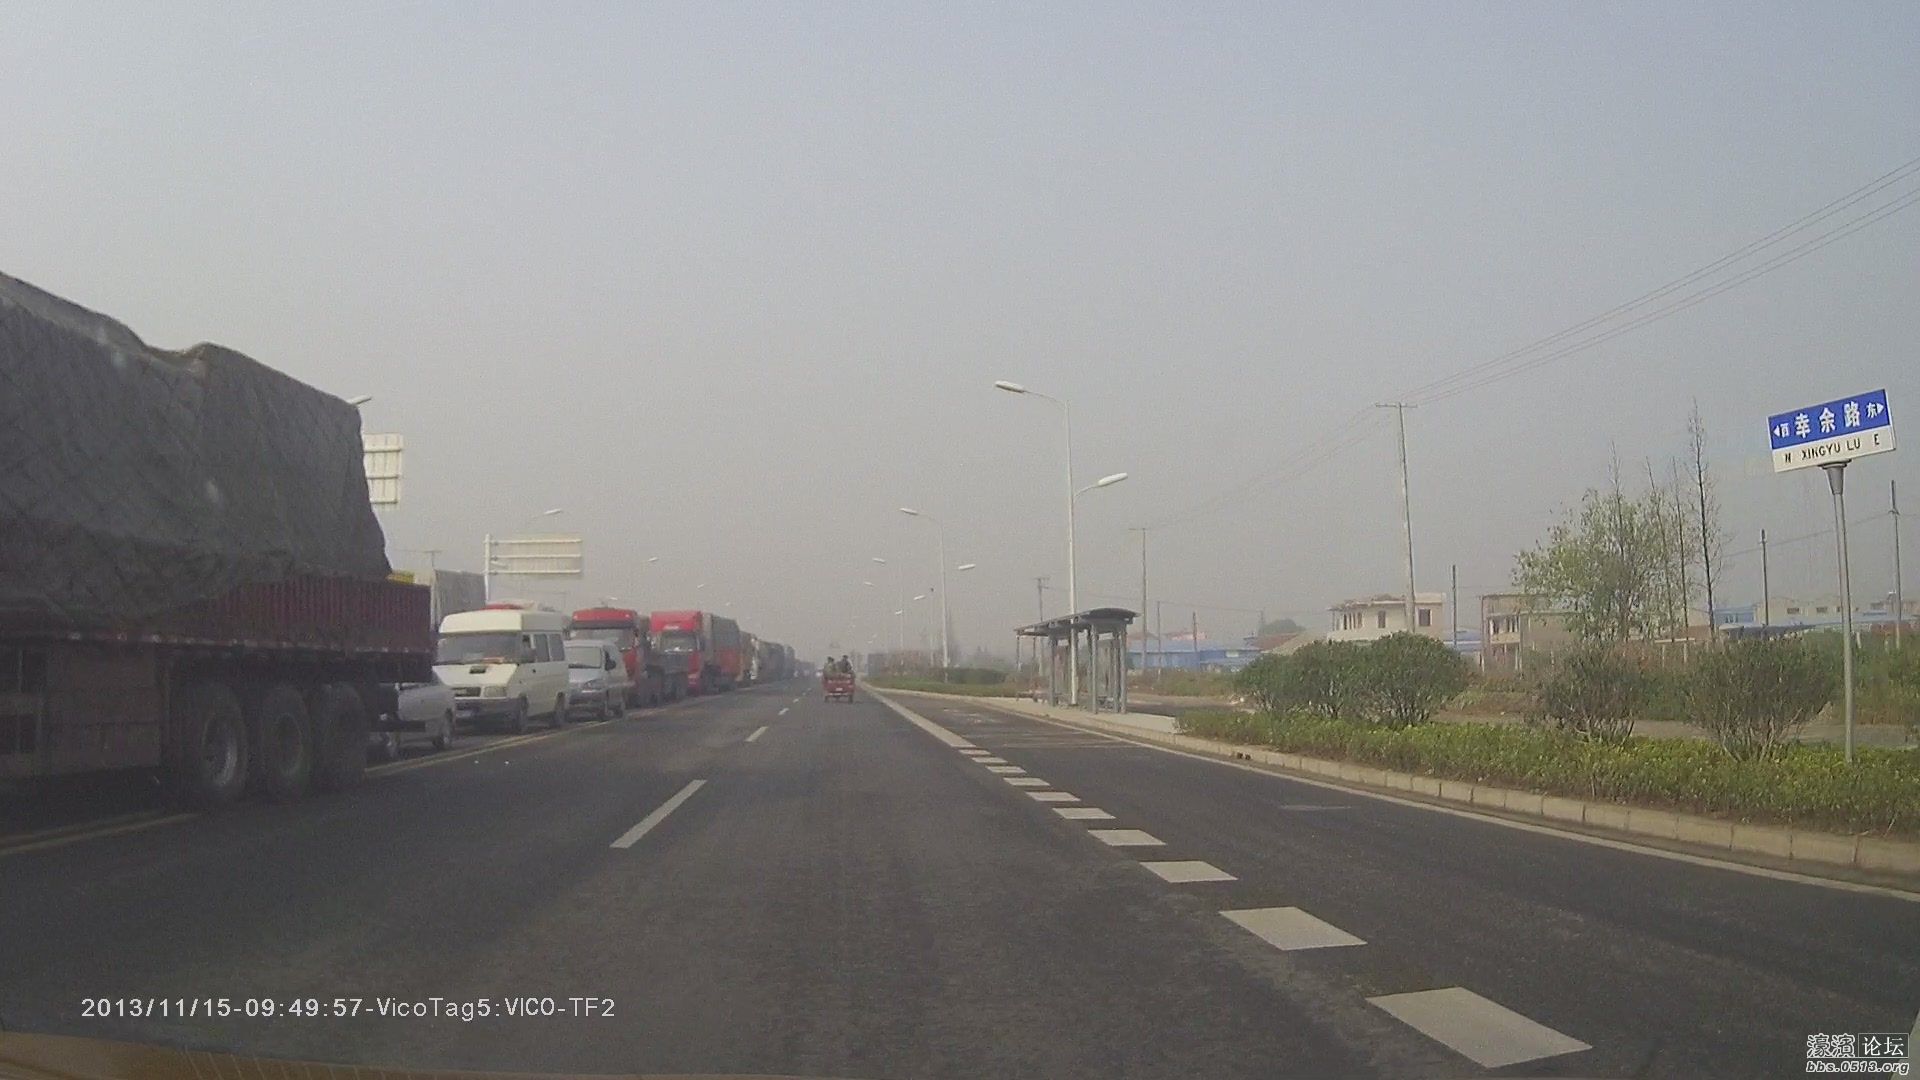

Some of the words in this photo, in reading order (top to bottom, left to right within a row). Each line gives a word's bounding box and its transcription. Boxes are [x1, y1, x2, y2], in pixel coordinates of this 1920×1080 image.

[1794, 401, 1861, 439] 幸余路
[1801, 443, 1841, 460] XINGYU
[1846, 438, 1861, 451] LU
[1873, 433, 1880, 446] E
